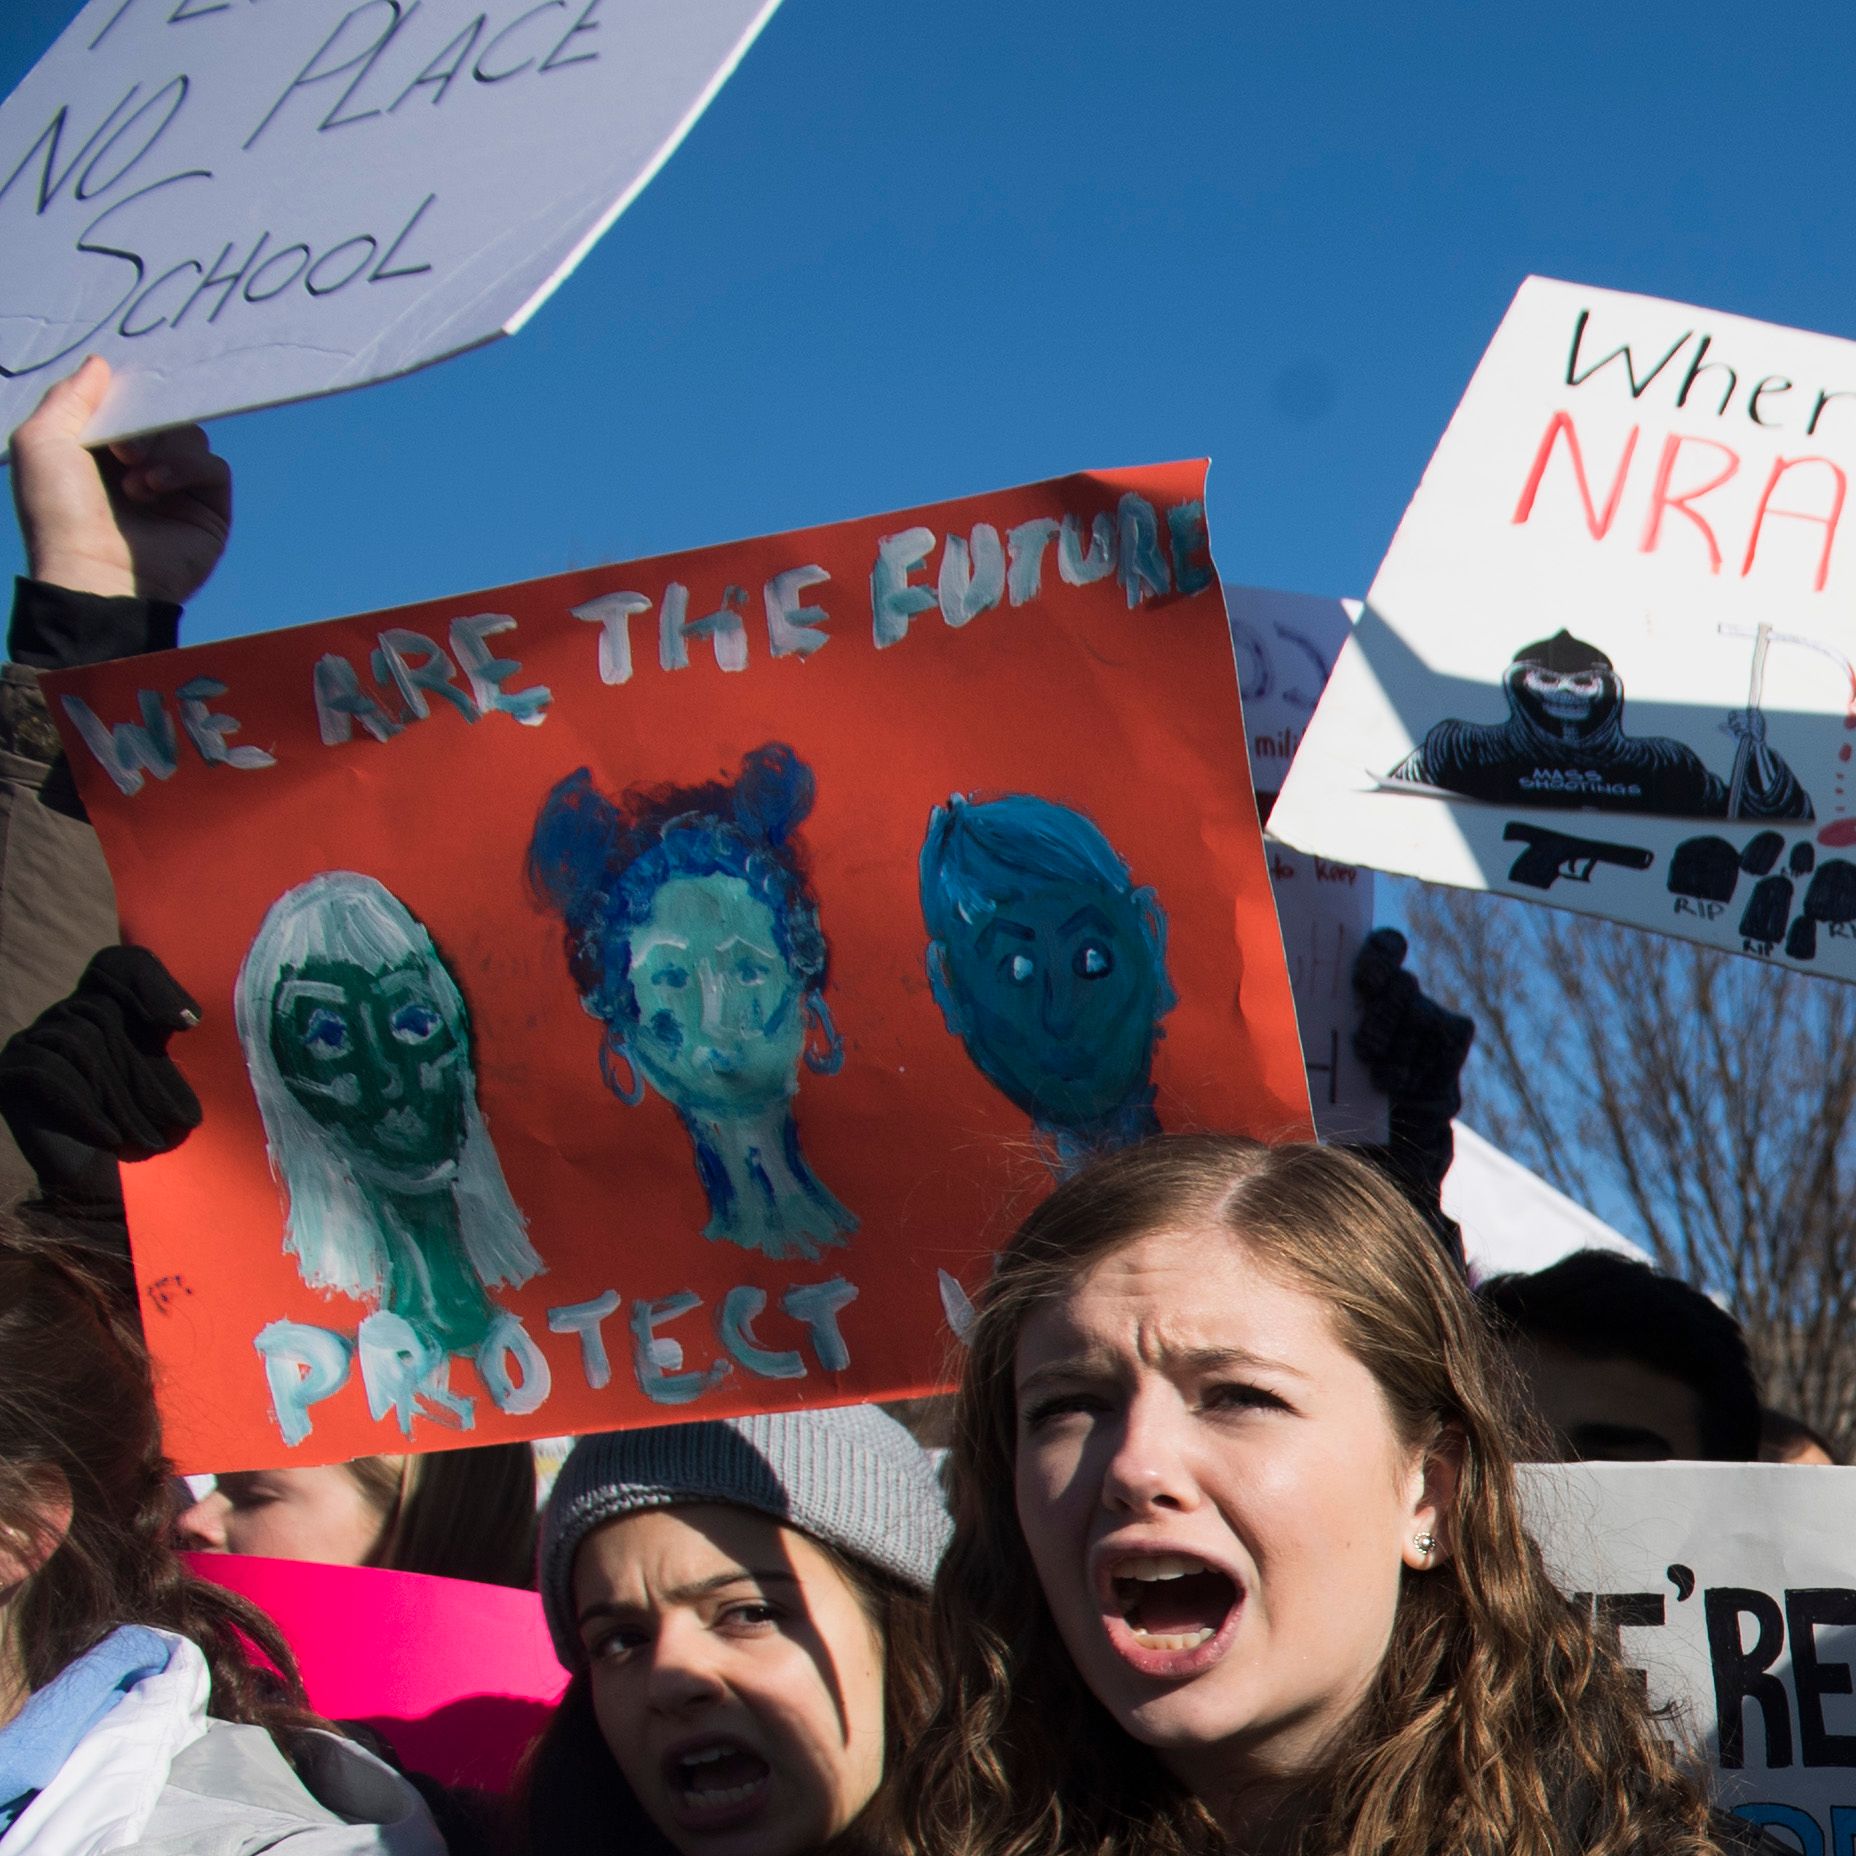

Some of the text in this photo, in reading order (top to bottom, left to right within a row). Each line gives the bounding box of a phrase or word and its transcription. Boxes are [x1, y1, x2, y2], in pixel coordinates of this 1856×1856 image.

[0, 0, 600, 215] NO PLACE
[1513, 411, 1845, 593] NRA
[61, 491, 1211, 795] WE ARE THE FUTURE
[1674, 898, 1725, 920] RIP
[256, 1278, 858, 1448] PROTECT
